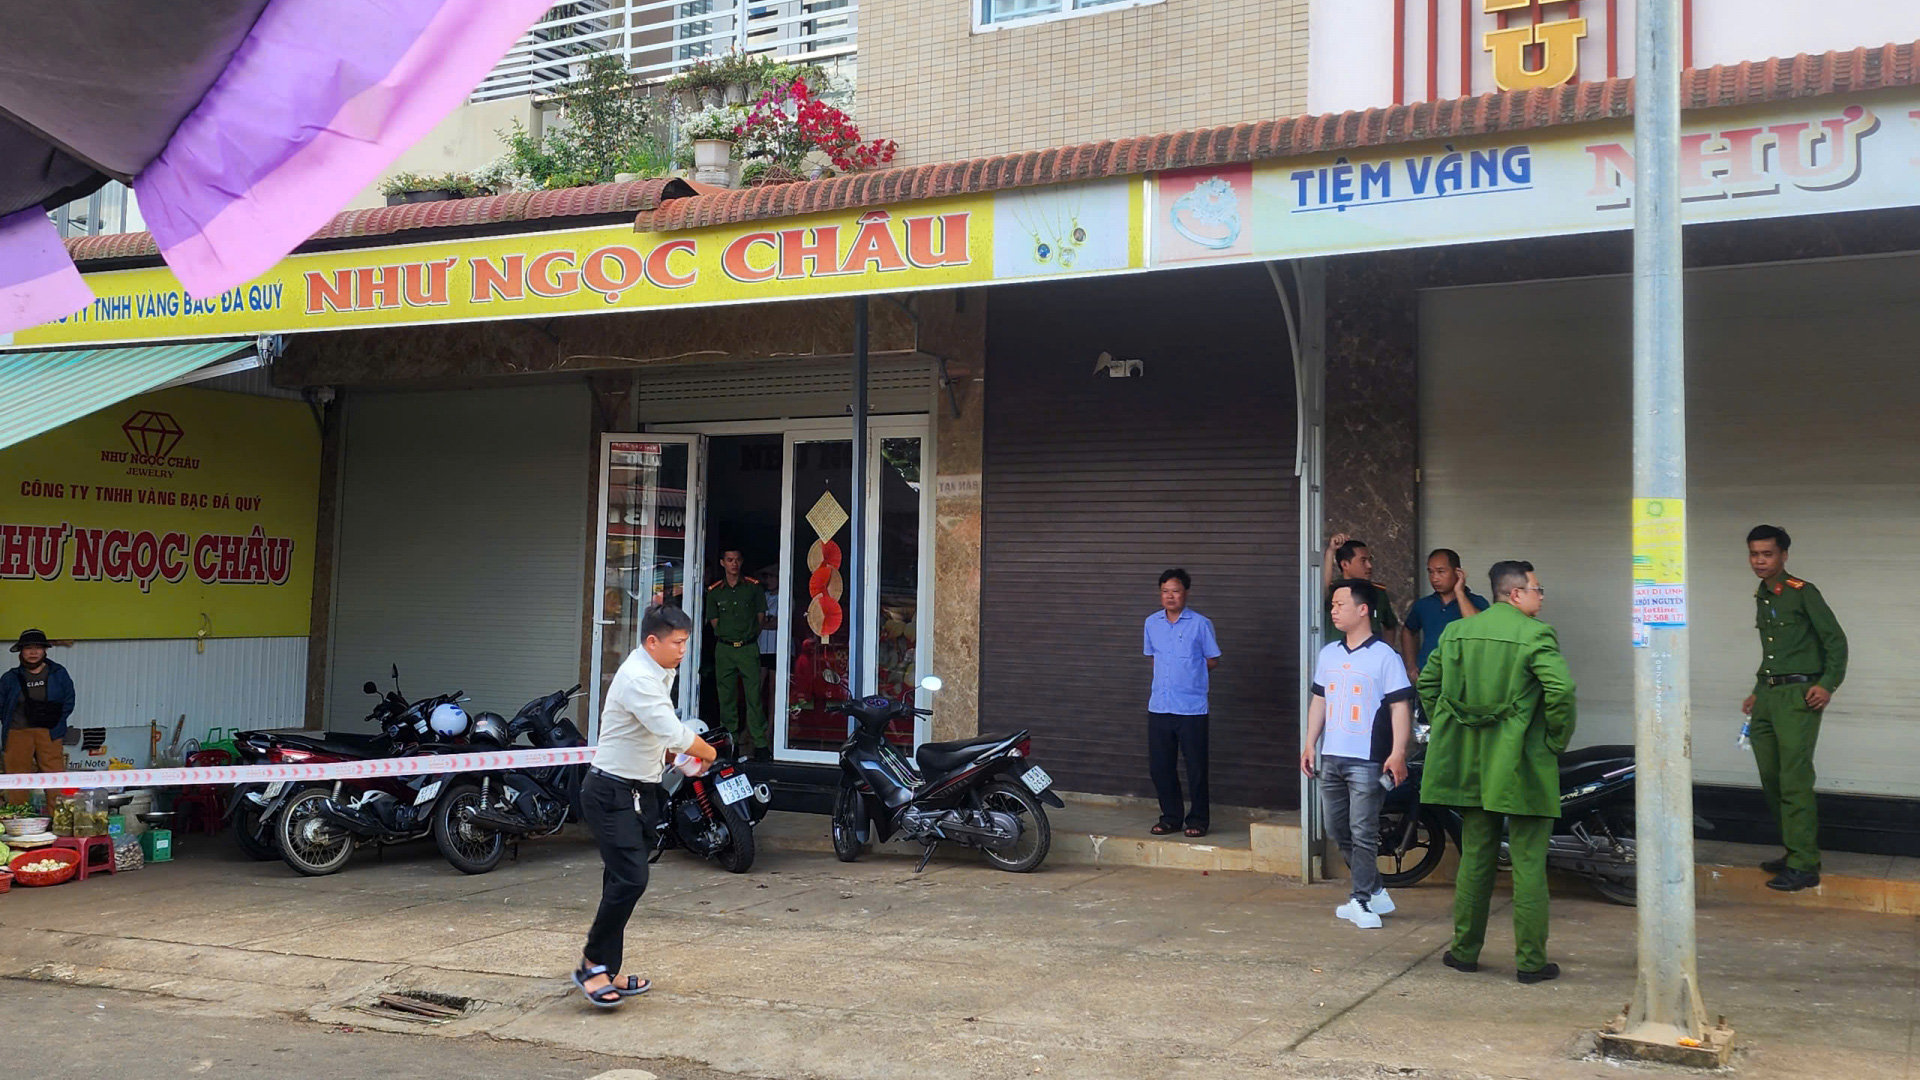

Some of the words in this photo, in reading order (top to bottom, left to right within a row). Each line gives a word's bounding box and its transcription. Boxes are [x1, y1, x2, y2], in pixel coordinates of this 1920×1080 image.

[1290, 157, 1391, 212] TIỆM
[1405, 143, 1532, 197] VÀNG
[94, 296, 131, 320] TNHH
[136, 289, 179, 317] VÀNG
[248, 278, 283, 311] QUÝ
[304, 256, 459, 315] NHƯ
[470, 239, 697, 303] NGỌC
[722, 209, 971, 283] CHÂU
[101, 450, 129, 463] NHƯ
[130, 453, 165, 468] NGỌC
[167, 456, 200, 469] CHÂU
[126, 467, 175, 479] JEWELRY
[21, 479, 64, 498] CÔNG
[70, 484, 89, 500] TY
[95, 486, 132, 503] TNHH
[138, 487, 176, 506] VÀNG
[180, 492, 208, 511] BẠC
[213, 492, 230, 510] ĐÁ
[235, 494, 261, 512] QUÝ
[0, 522, 71, 581] HƯ
[72, 529, 189, 594] NGỌC
[193, 524, 294, 586] CHÂU
[26, 680, 45, 688] CIAO
[85, 759, 107, 768] Note
[120, 757, 135, 765] Pro
